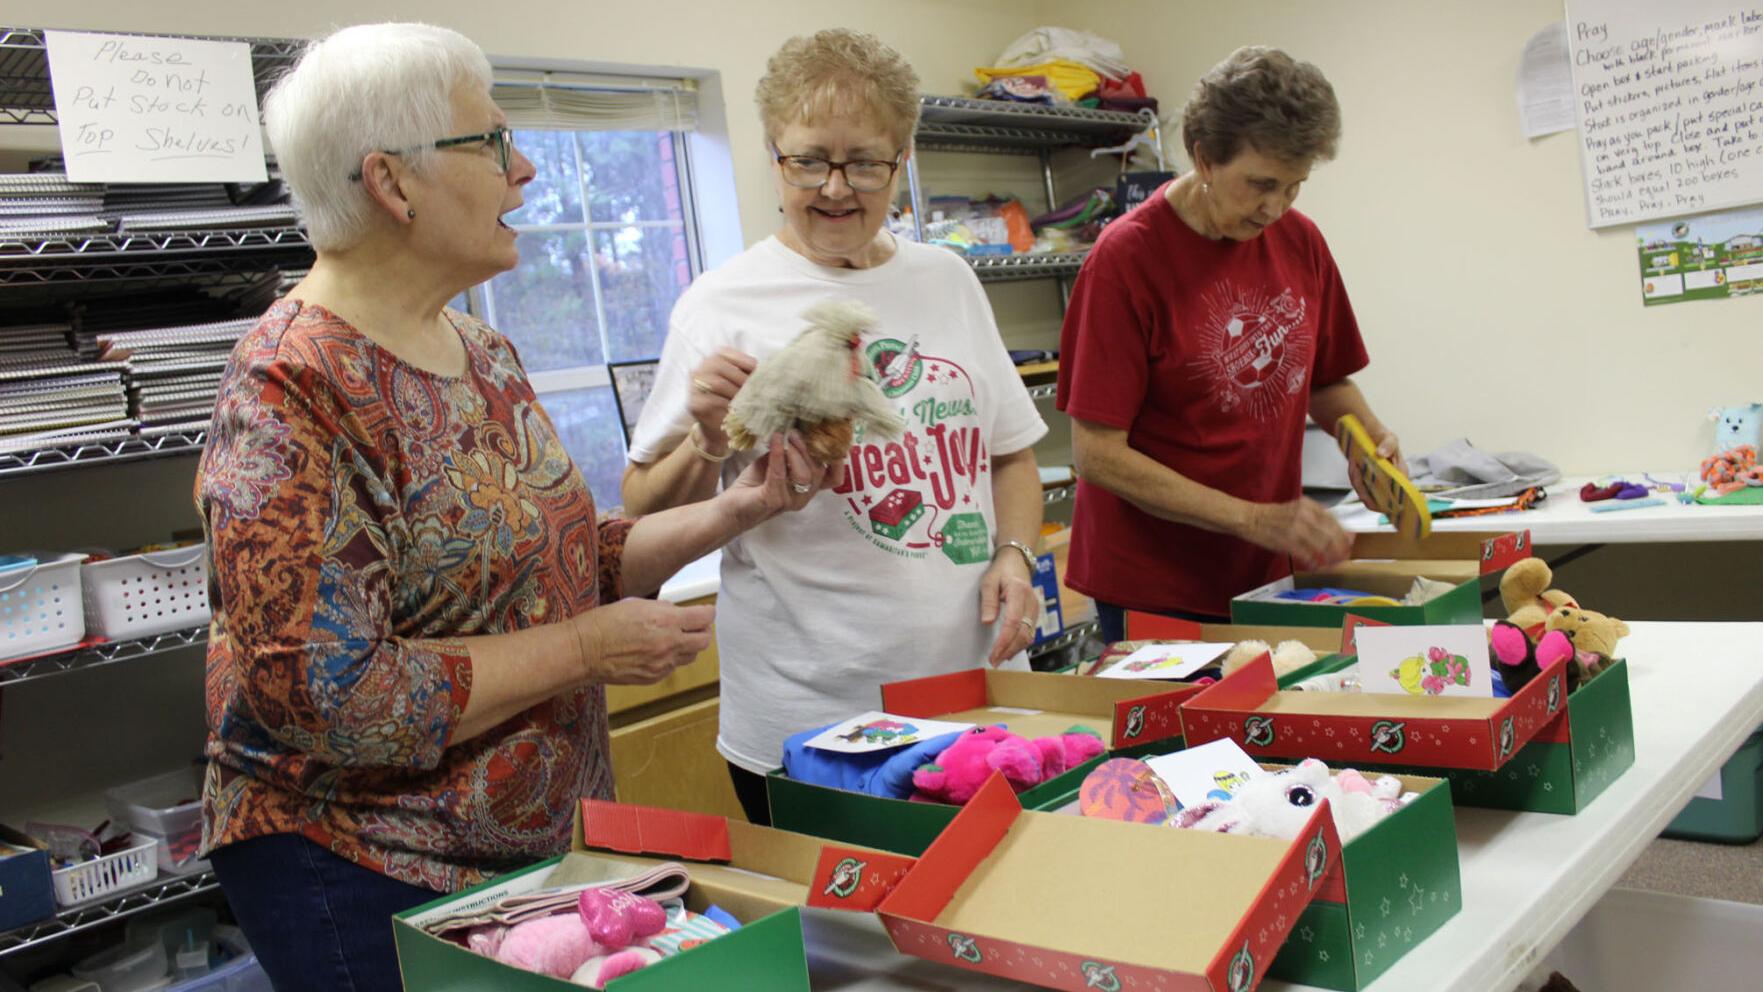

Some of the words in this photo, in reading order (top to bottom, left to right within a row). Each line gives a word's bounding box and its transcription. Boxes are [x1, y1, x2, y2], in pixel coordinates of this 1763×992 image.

[1576, 22, 1608, 41] Pray
[94, 41, 192, 65] Please
[130, 69, 156, 87] Do
[1581, 83, 1609, 98] Open
[71, 86, 117, 110] Put
[221, 104, 251, 122] on
[1584, 98, 1603, 114] Put
[1688, 96, 1700, 105] in
[1706, 122, 1728, 136] and
[1585, 137, 1607, 151] Pray
[1609, 135, 1622, 146] as
[1623, 131, 1643, 146] you
[1686, 154, 1716, 172] high
[1639, 180, 1670, 200] equal
[1676, 175, 1698, 188] 200
[1701, 168, 1739, 182] boxes
